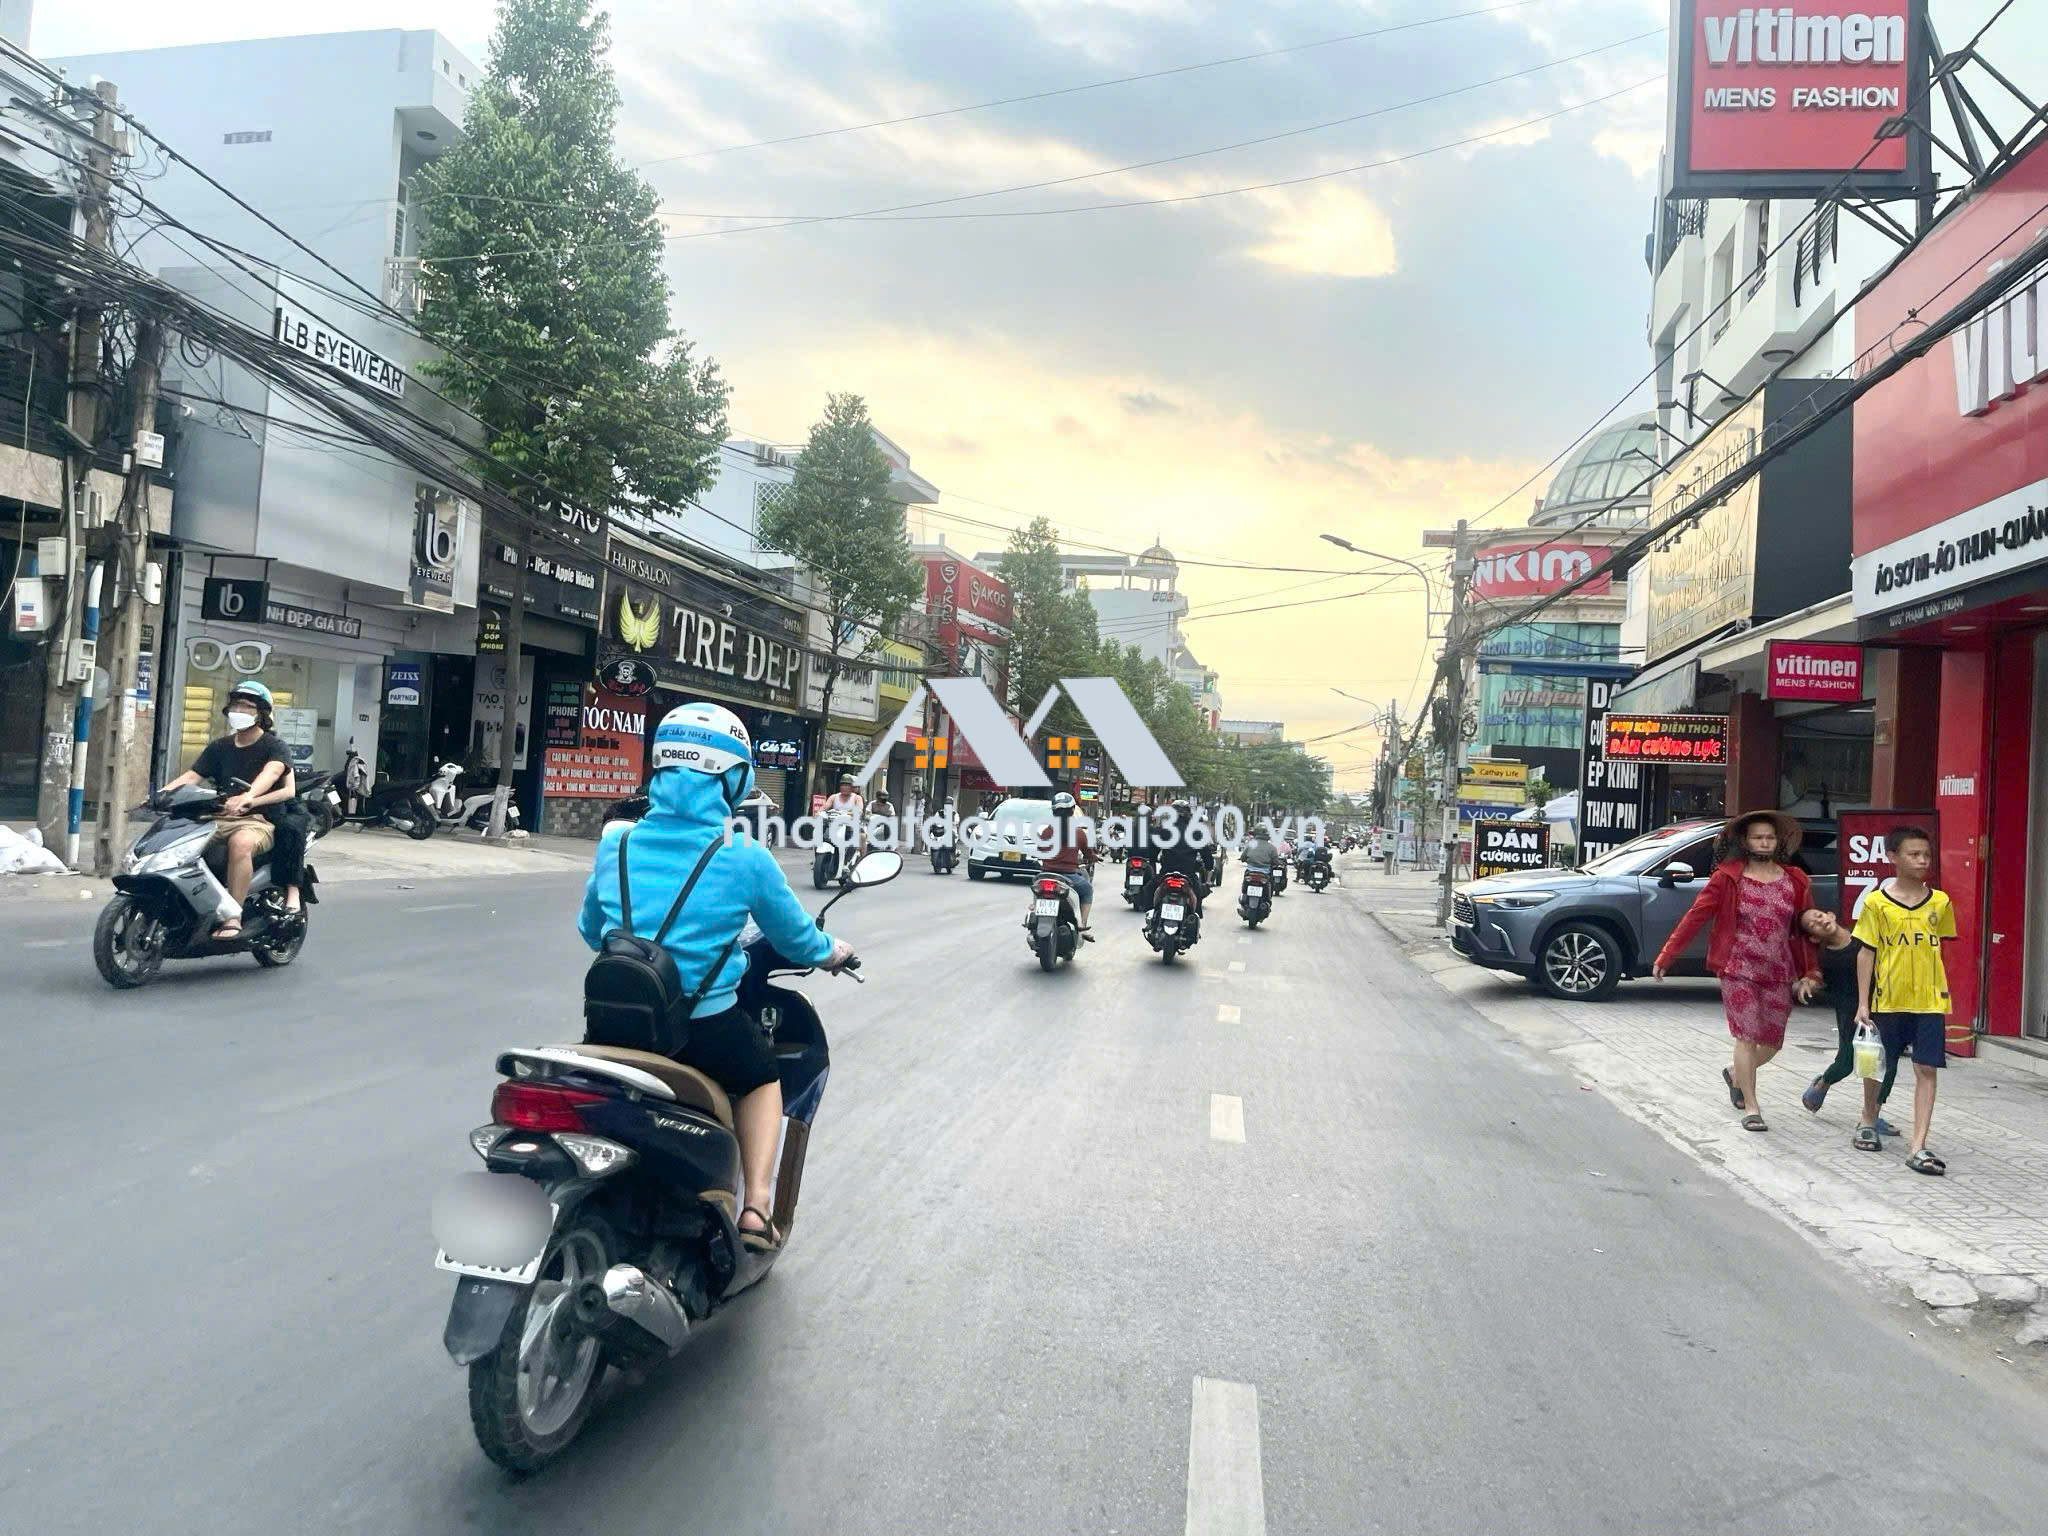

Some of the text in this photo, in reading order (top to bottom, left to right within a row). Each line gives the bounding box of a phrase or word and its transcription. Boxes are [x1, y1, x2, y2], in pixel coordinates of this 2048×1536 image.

[1704, 8, 1905, 65] vitimen
[1704, 86, 1899, 109] MENS FASHION
[314, 329, 404, 393] EYEWEAR
[416, 566, 452, 583] EYEWEAR
[534, 556, 551, 575] iPad
[555, 564, 575, 583] Apple
[575, 570, 595, 589] Watch
[612, 550, 671, 587] HAIR SALON
[1874, 563, 1894, 595] ÁO
[1894, 556, 1915, 588] SƠ
[287, 611, 313, 628] ĐẸP
[314, 613, 335, 631] GIÁ
[337, 617, 361, 636] TỐT
[486, 621, 501, 630] TRẢ
[480, 642, 504, 651] IPHONE
[484, 632, 501, 640] GÓP
[672, 602, 737, 676] TRẺ
[743, 632, 801, 700] ĐẸP
[391, 671, 421, 681] ZEISS
[1775, 654, 1857, 677] vitimen
[1775, 678, 1856, 690] MENS FASHION
[390, 694, 418, 702] PARTNER
[548, 705, 579, 717] IPHONE
[612, 711, 647, 735] NAM
[661, 749, 701, 761] KOBELCO
[1609, 735, 1722, 761] DÁN CƯỜNG LỰC
[1480, 768, 1519, 777] Cathay Life
[1587, 756, 1605, 787] ÉP
[1939, 774, 1975, 796] vitimen
[1467, 808, 1508, 820] vivo
[1586, 801, 1637, 830] THAY PIN
[1487, 828, 1538, 850] DÁN
[1849, 834, 1890, 864] SA
[1480, 849, 1543, 867] CƯỜNG LỰC
[1848, 869, 1875, 877] UP TO
[471, 1285, 491, 1295] BT
